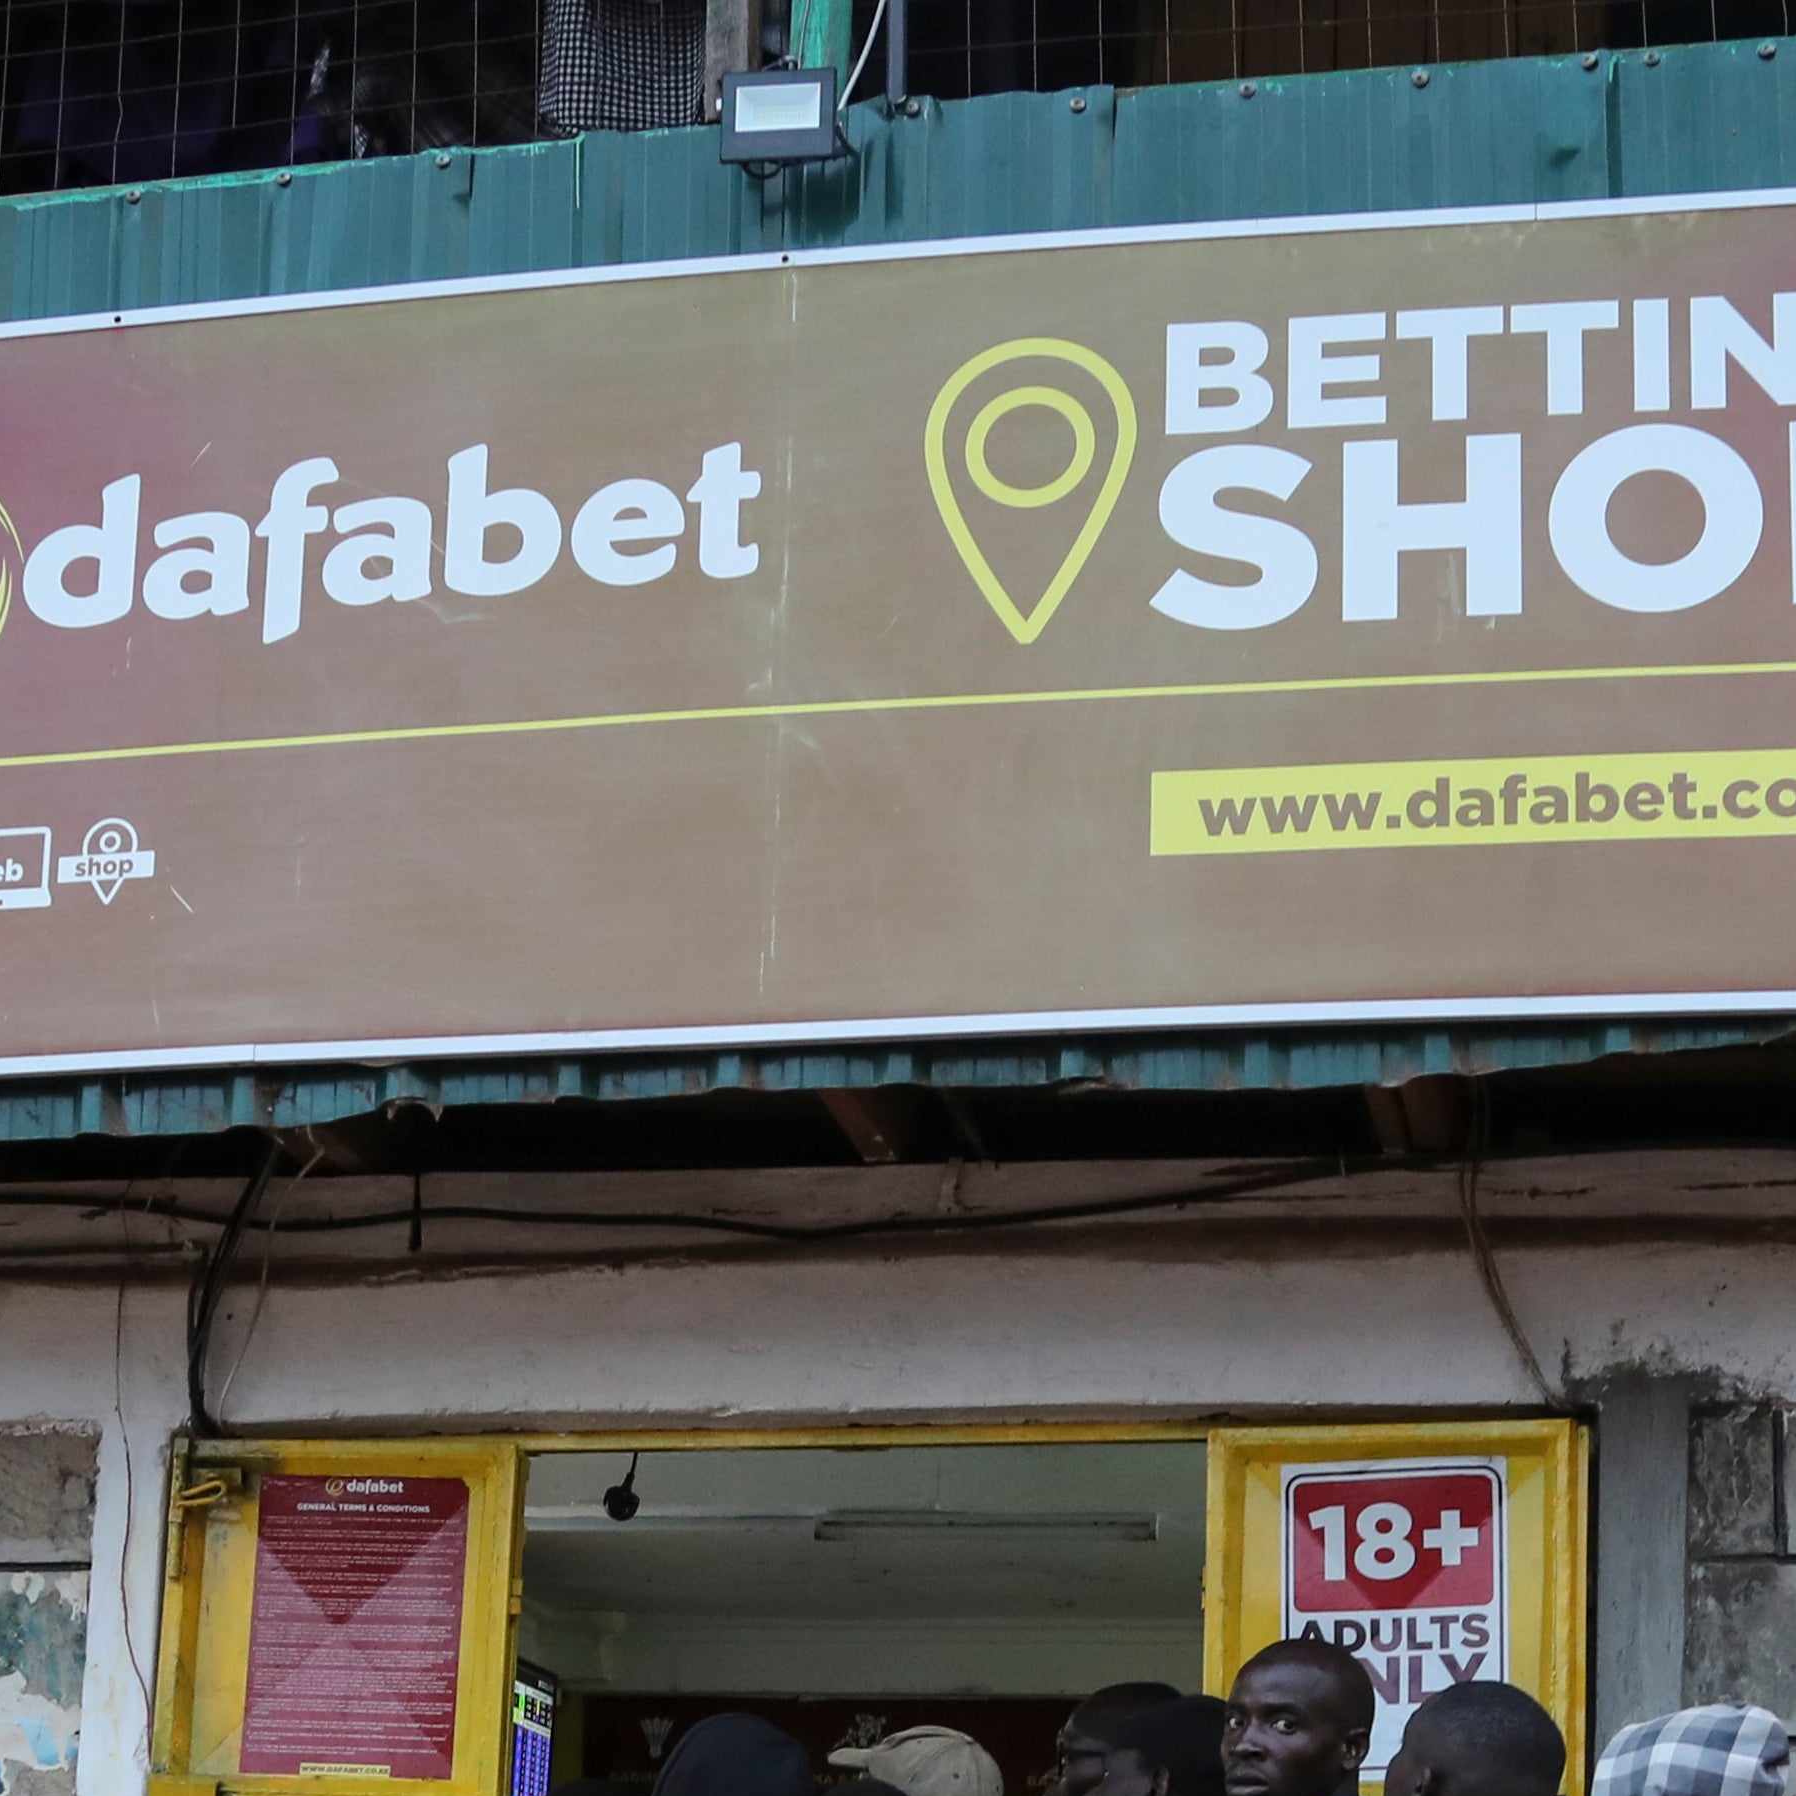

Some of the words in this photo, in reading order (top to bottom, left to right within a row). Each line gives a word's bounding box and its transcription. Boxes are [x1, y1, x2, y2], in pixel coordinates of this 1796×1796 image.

[23, 442, 761, 644] dafabet
[74, 852, 134, 879] shop
[346, 1479, 404, 1495] dafabet
[296, 1502, 336, 1512] GENERAL
[338, 1503, 366, 1512] TERMS
[376, 1504, 430, 1513] CONDITIONS
[1308, 1501, 1479, 1581] 18+
[1356, 1654, 1488, 1704] NLY
